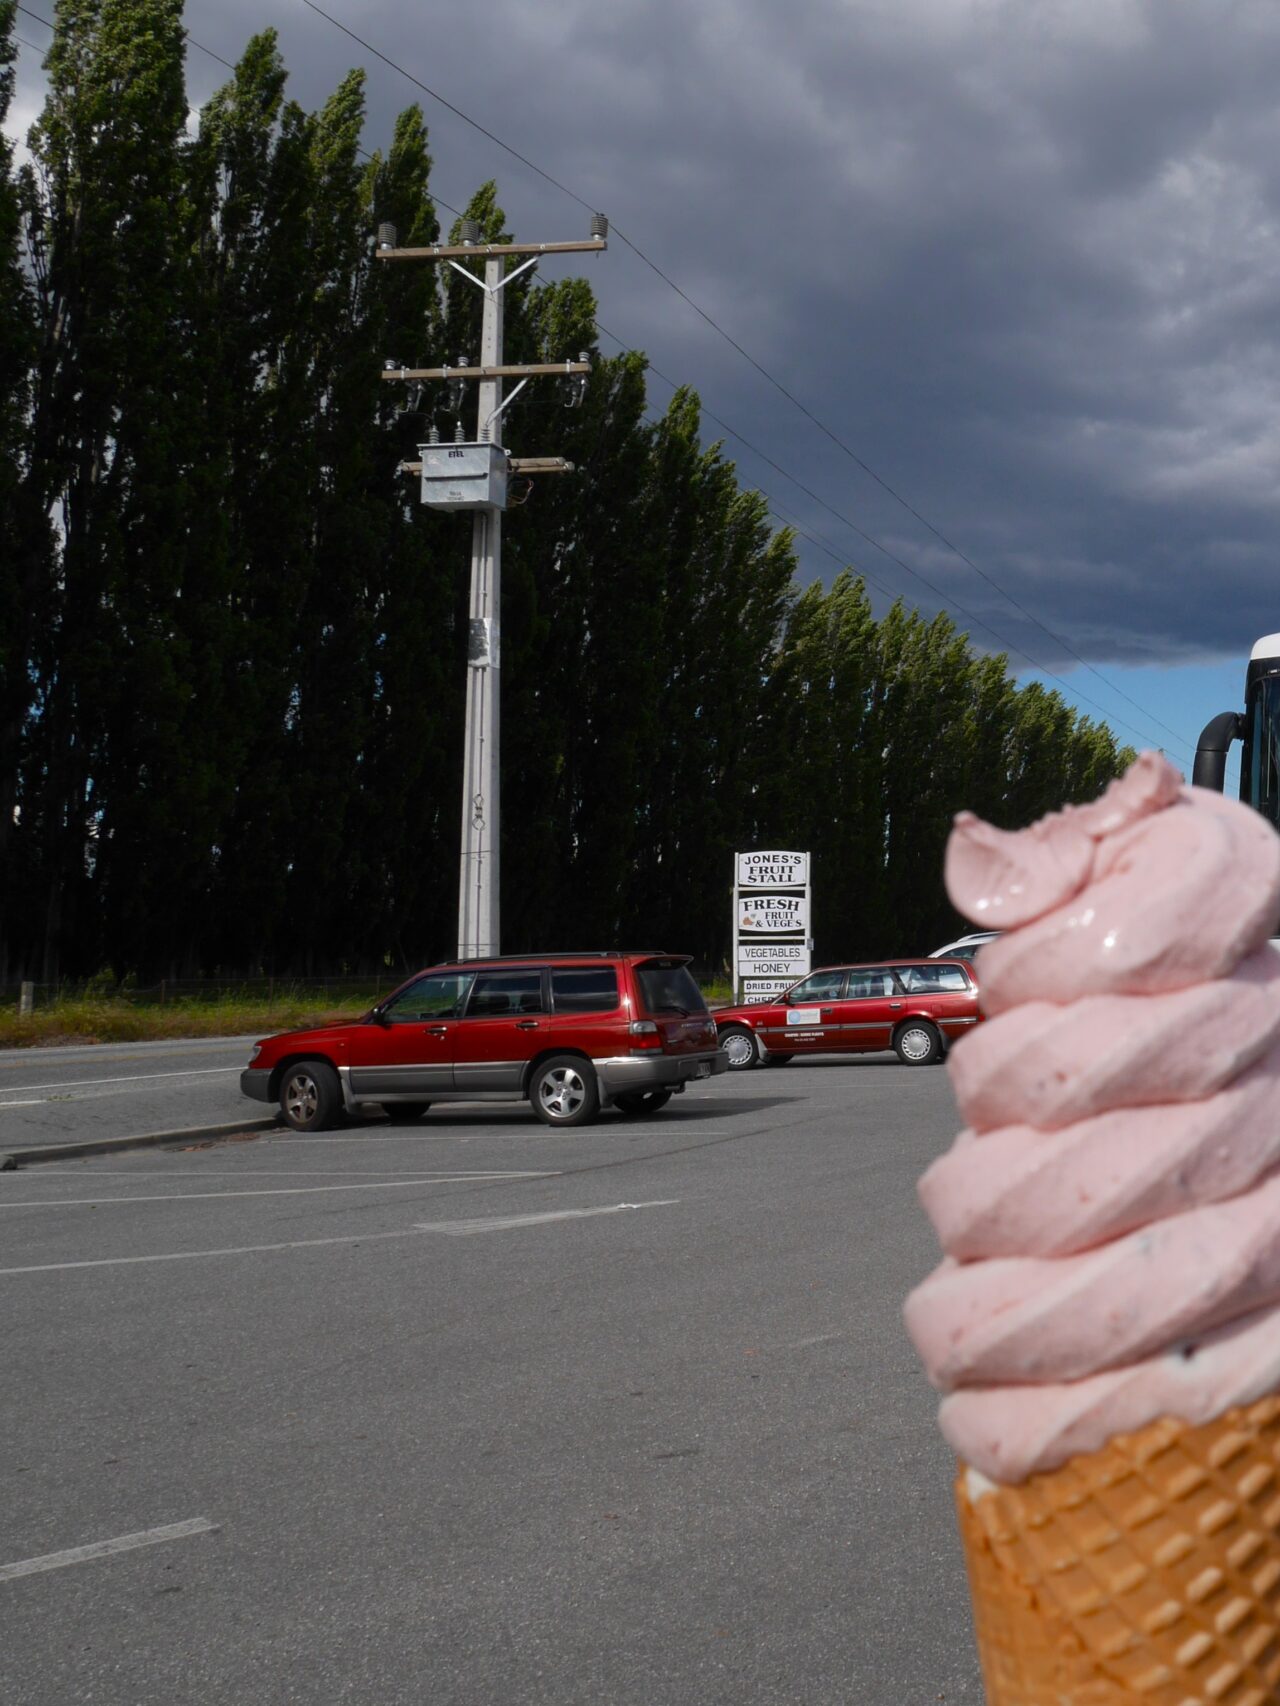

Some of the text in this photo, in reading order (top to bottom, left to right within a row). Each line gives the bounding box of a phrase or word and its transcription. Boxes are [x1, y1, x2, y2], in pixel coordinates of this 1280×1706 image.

[744, 854, 802, 865] JONES'S
[749, 865, 797, 875] FRUIT
[747, 874, 796, 884] STALL
[743, 899, 800, 912] FRESH
[764, 911, 795, 920] FRUIT
[755, 919, 764, 928] &
[744, 947, 801, 958] VEGETABLES
[753, 963, 791, 974] HONEY
[746, 982, 772, 990] DRIED
